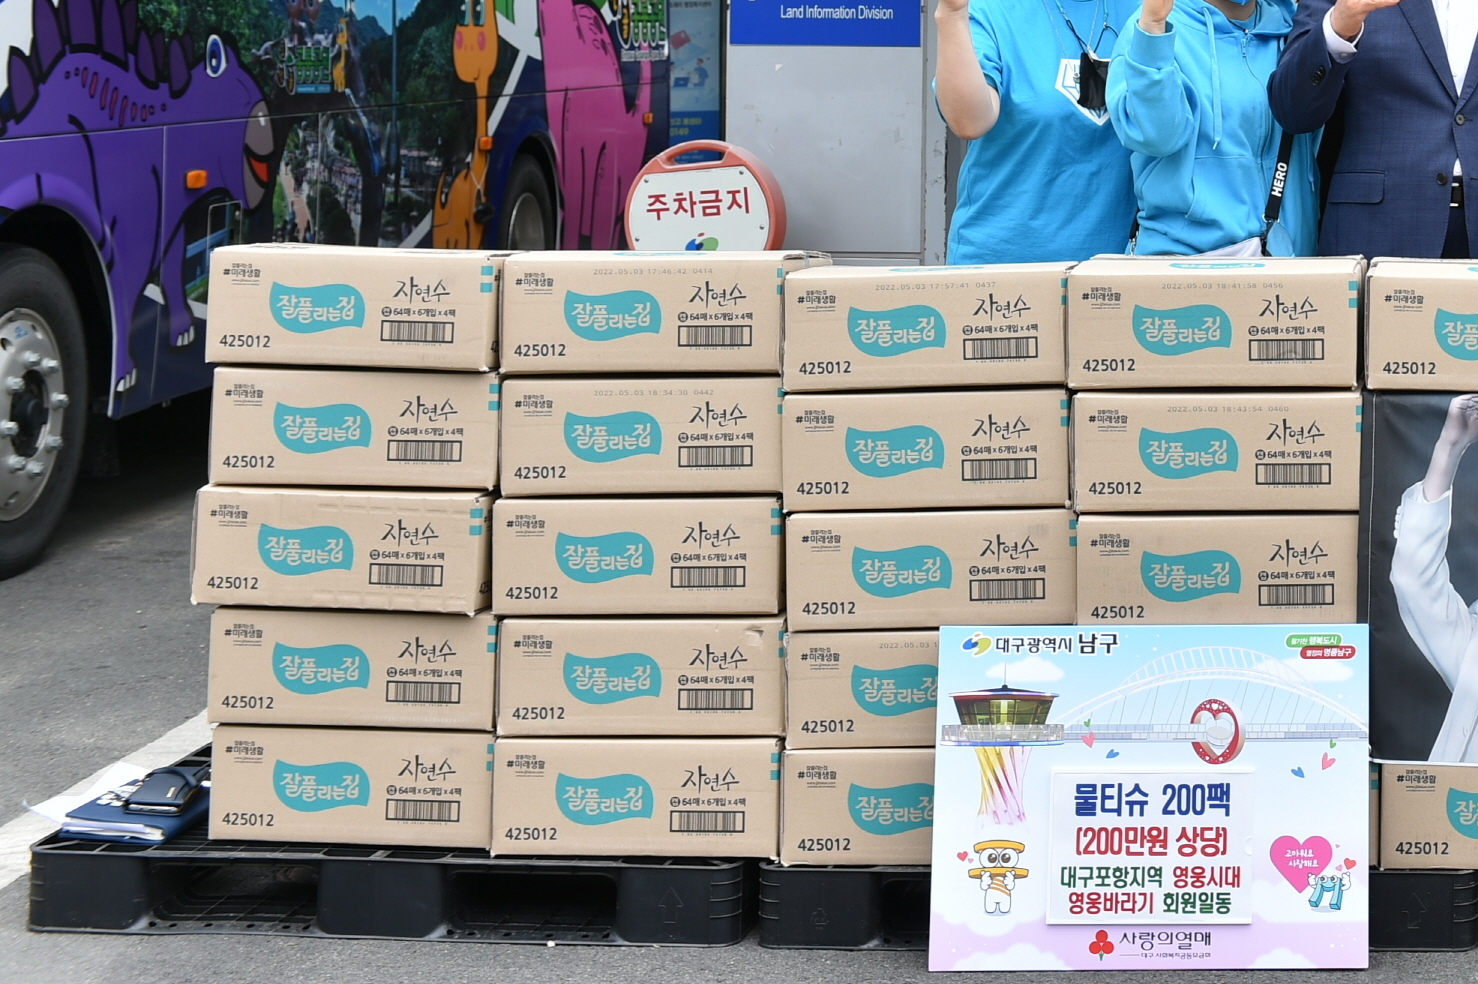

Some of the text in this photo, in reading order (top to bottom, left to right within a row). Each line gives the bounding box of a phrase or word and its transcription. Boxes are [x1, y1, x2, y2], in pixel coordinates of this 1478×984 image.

[780, 4, 894, 20] Land Information Division
[1271, 161, 1288, 197] HERO
[646, 186, 750, 221] 주차금지
[393, 277, 453, 304] 자연수
[690, 282, 748, 308] 자연수
[570, 302, 653, 331] 잘풀리는집
[974, 294, 1032, 320] 자연수
[219, 333, 272, 349] 425012
[1139, 316, 1222, 345] 잘풀리는집
[514, 343, 567, 359] 425012
[799, 360, 852, 376] 425012
[1383, 360, 1438, 376] 425012
[278, 414, 363, 444] 잘풀리는집
[222, 454, 277, 470] 425012
[852, 438, 935, 467] 잘풀리는집
[1089, 481, 1142, 497] 425012
[381, 520, 441, 547] 자연수
[683, 522, 741, 548] 자연수
[562, 544, 645, 573] 잘풀리는집
[981, 535, 1039, 561] 자연수
[1270, 540, 1328, 566] 자연수
[505, 585, 560, 601] 425012
[802, 601, 857, 617] 425012
[996, 633, 1118, 654] 대구광역시 남구
[278, 655, 361, 684] 잘풀리는집
[221, 694, 276, 710] 425012
[560, 785, 645, 815] 잘풀리는집
[1074, 782, 1231, 817] 물티슈 200팩
[505, 826, 558, 842] 425012
[798, 837, 851, 853] 425012
[1395, 841, 1450, 857] 425012
[1060, 866, 1241, 889] 대구포항지역 영웅시대
[1068, 891, 1232, 914] 영웅바라기 회원일동
[1119, 931, 1211, 951] 사랑의열매
